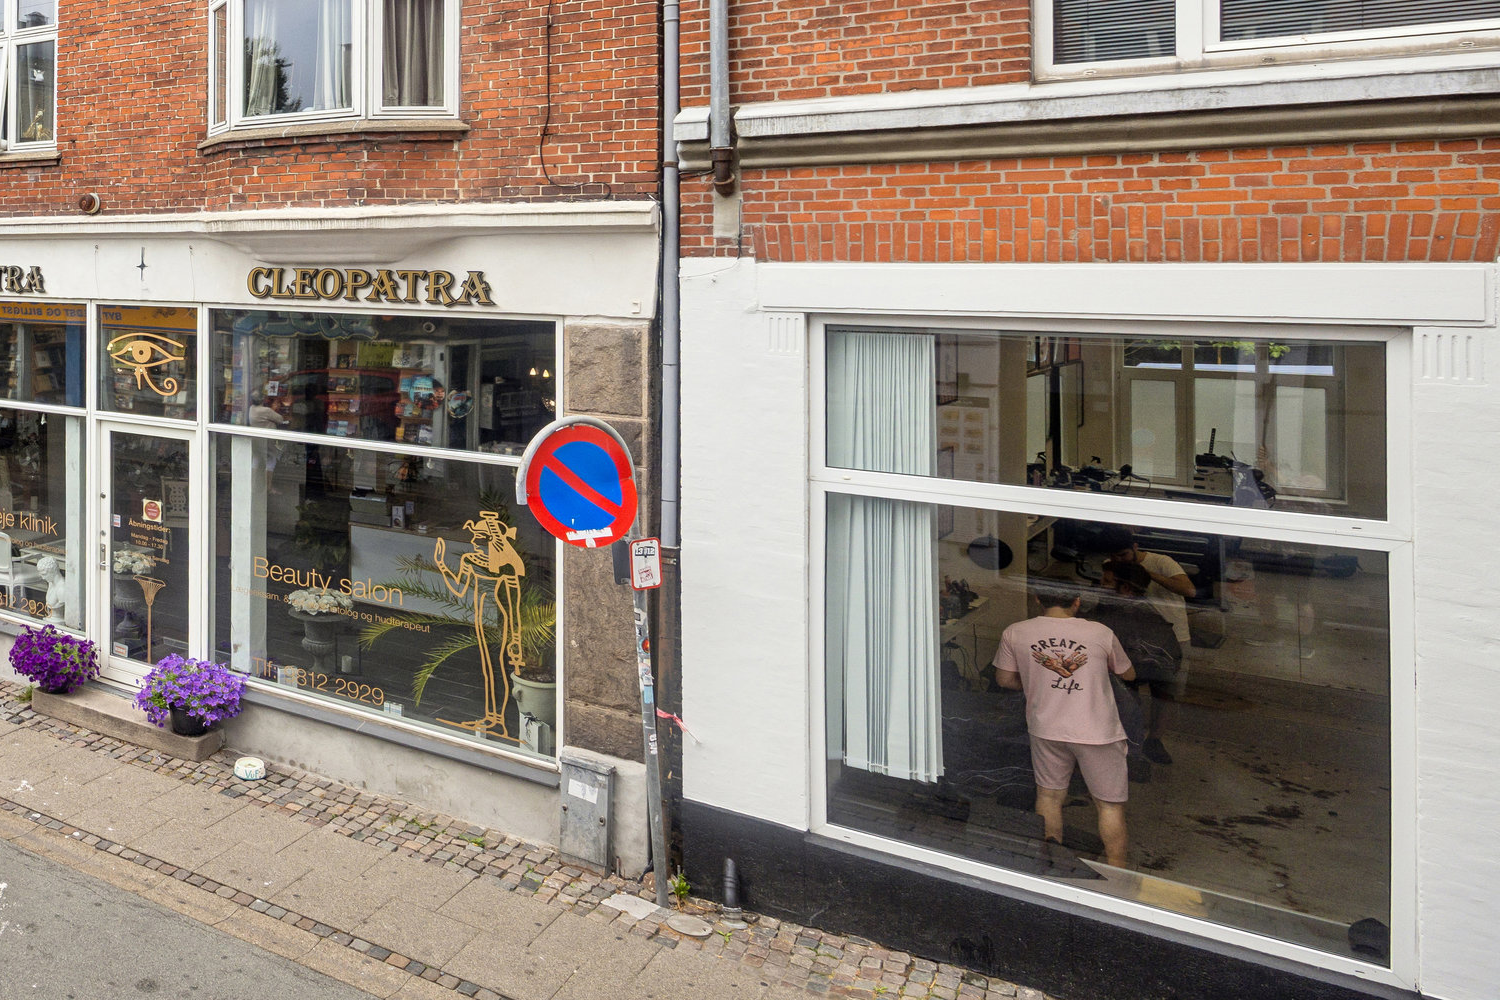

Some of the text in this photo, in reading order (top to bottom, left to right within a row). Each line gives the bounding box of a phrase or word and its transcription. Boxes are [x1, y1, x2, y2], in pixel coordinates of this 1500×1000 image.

[247, 267, 496, 307] CLEOPATRA
[20, 511, 58, 536] klinik
[128, 517, 171, 533] Åbningstider:
[253, 556, 403, 606] Beauty salon
[20, 597, 53, 618] 2929
[360, 612, 373, 623] og
[375, 614, 431, 634] hudterapeut
[1030, 638, 1087, 652] CREATE
[252, 656, 384, 706] Tlf: 9812 2929
[1051, 676, 1084, 694] Life
